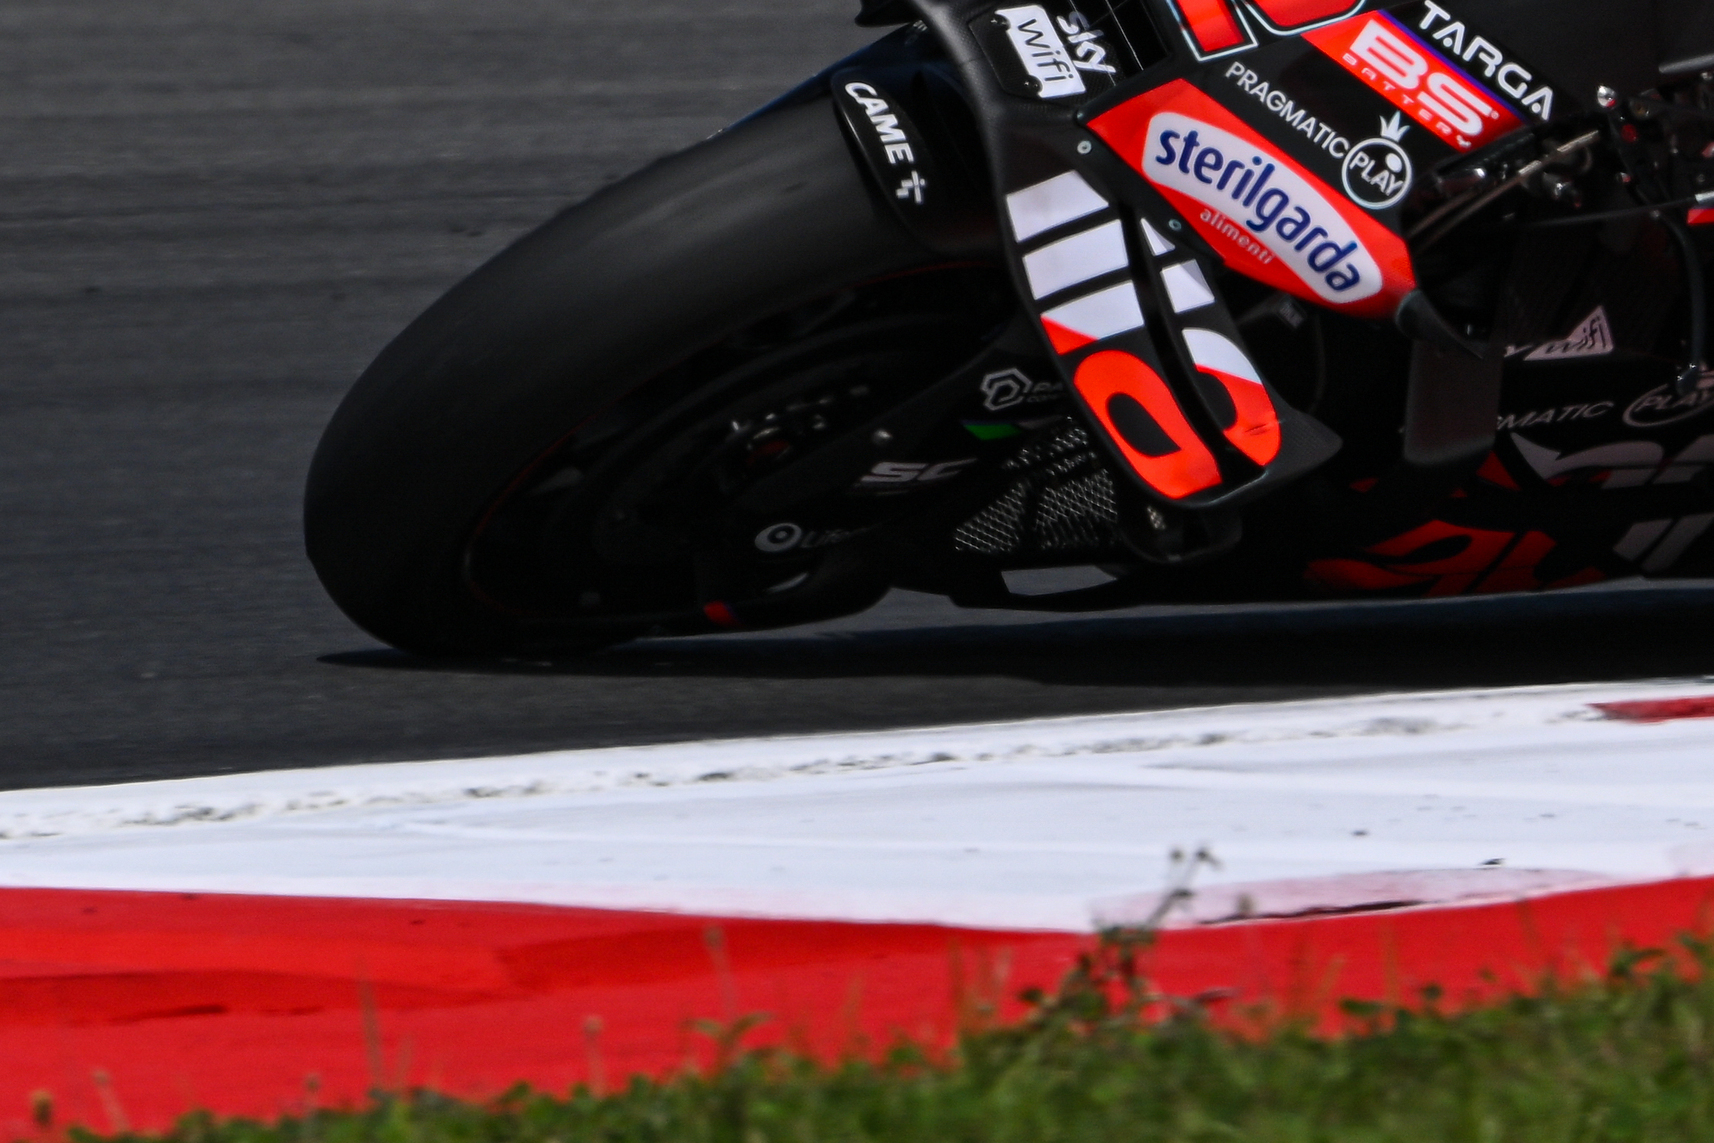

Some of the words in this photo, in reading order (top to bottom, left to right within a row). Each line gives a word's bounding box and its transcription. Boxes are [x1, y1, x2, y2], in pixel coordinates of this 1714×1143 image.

[1057, 10, 1116, 76] sky
[1349, 20, 1493, 139] BS
[1420, 0, 1556, 122] TARGA
[844, 81, 914, 166] CAME
[1224, 62, 1350, 159] PRAGMATIC
[1349, 152, 1401, 196] PLAY
[1341, 52, 1473, 149] BATTERY
[1154, 128, 1361, 294] sterilgarda
[1200, 207, 1275, 266] alimenti
[1497, 400, 1616, 431] MATIC
